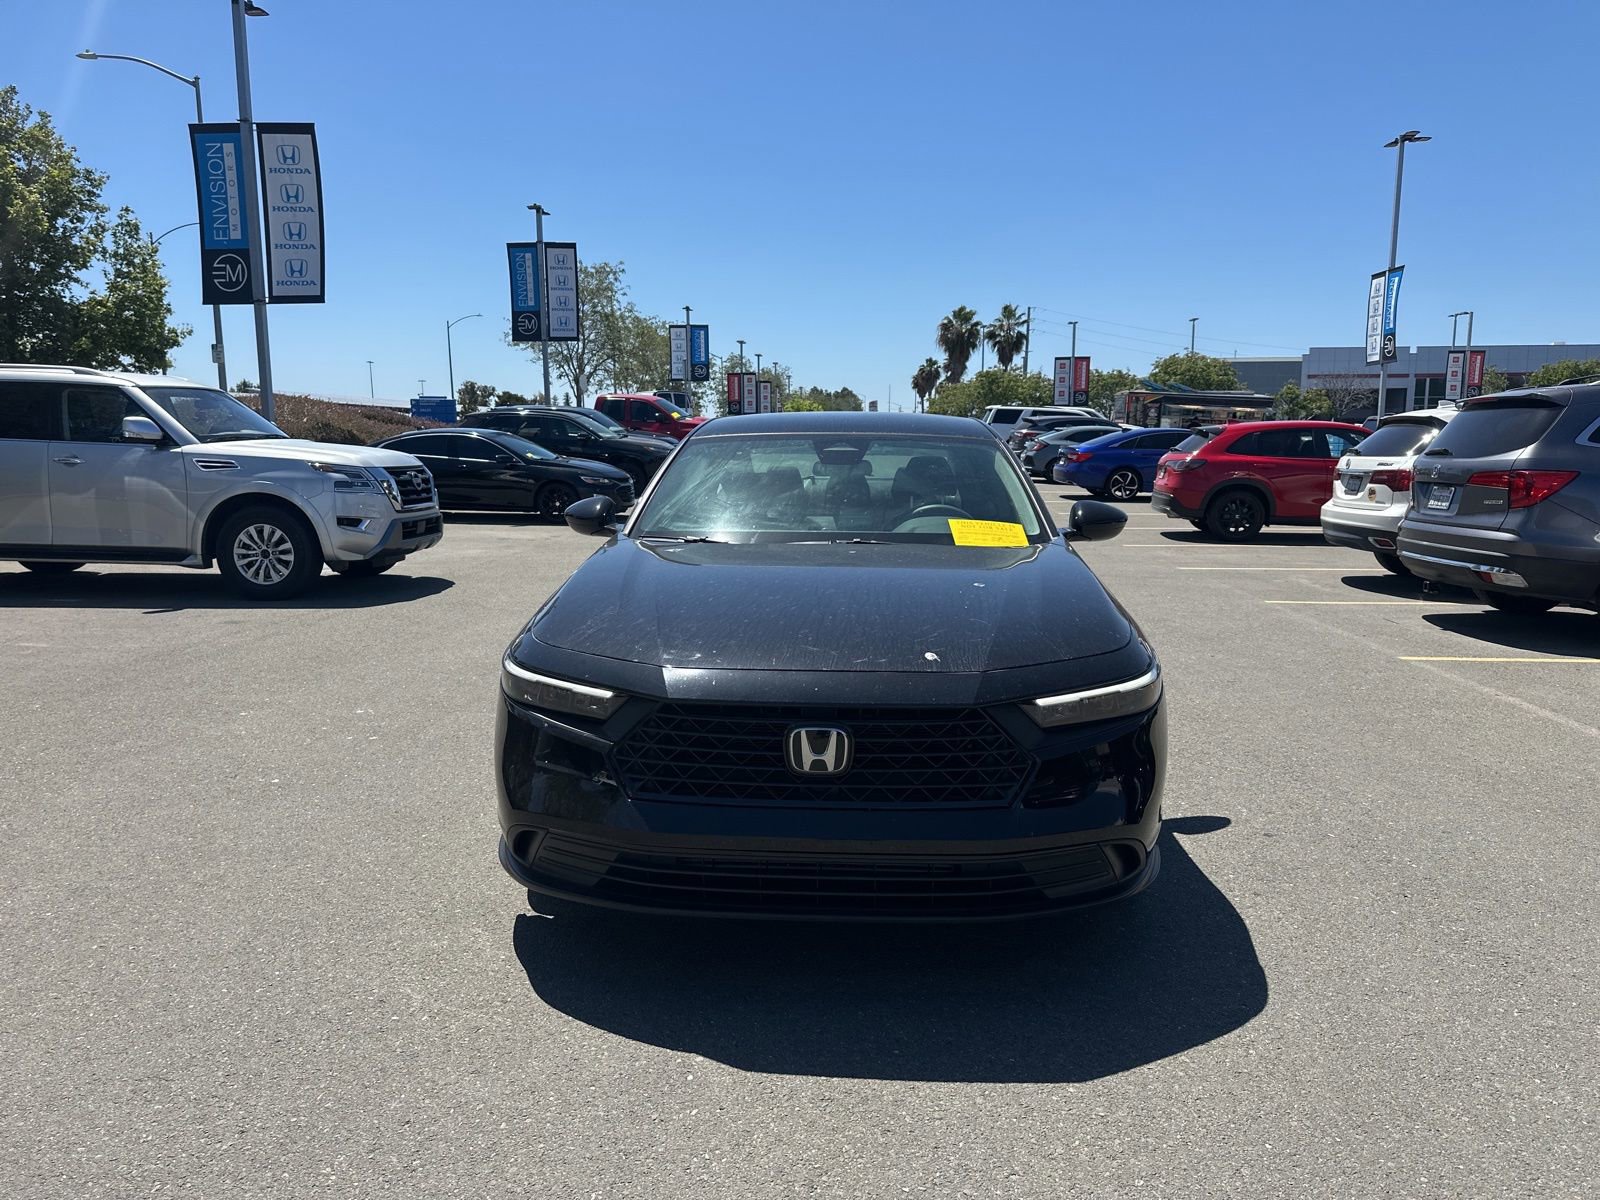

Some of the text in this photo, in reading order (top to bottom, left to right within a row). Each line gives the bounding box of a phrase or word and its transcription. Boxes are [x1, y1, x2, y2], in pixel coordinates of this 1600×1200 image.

[205, 143, 229, 241] ENVISION
[226, 151, 239, 232] MOTORS
[268, 167, 312, 175] HONDA
[272, 205, 315, 213] HONDA
[515, 252, 528, 307] ENVISION
